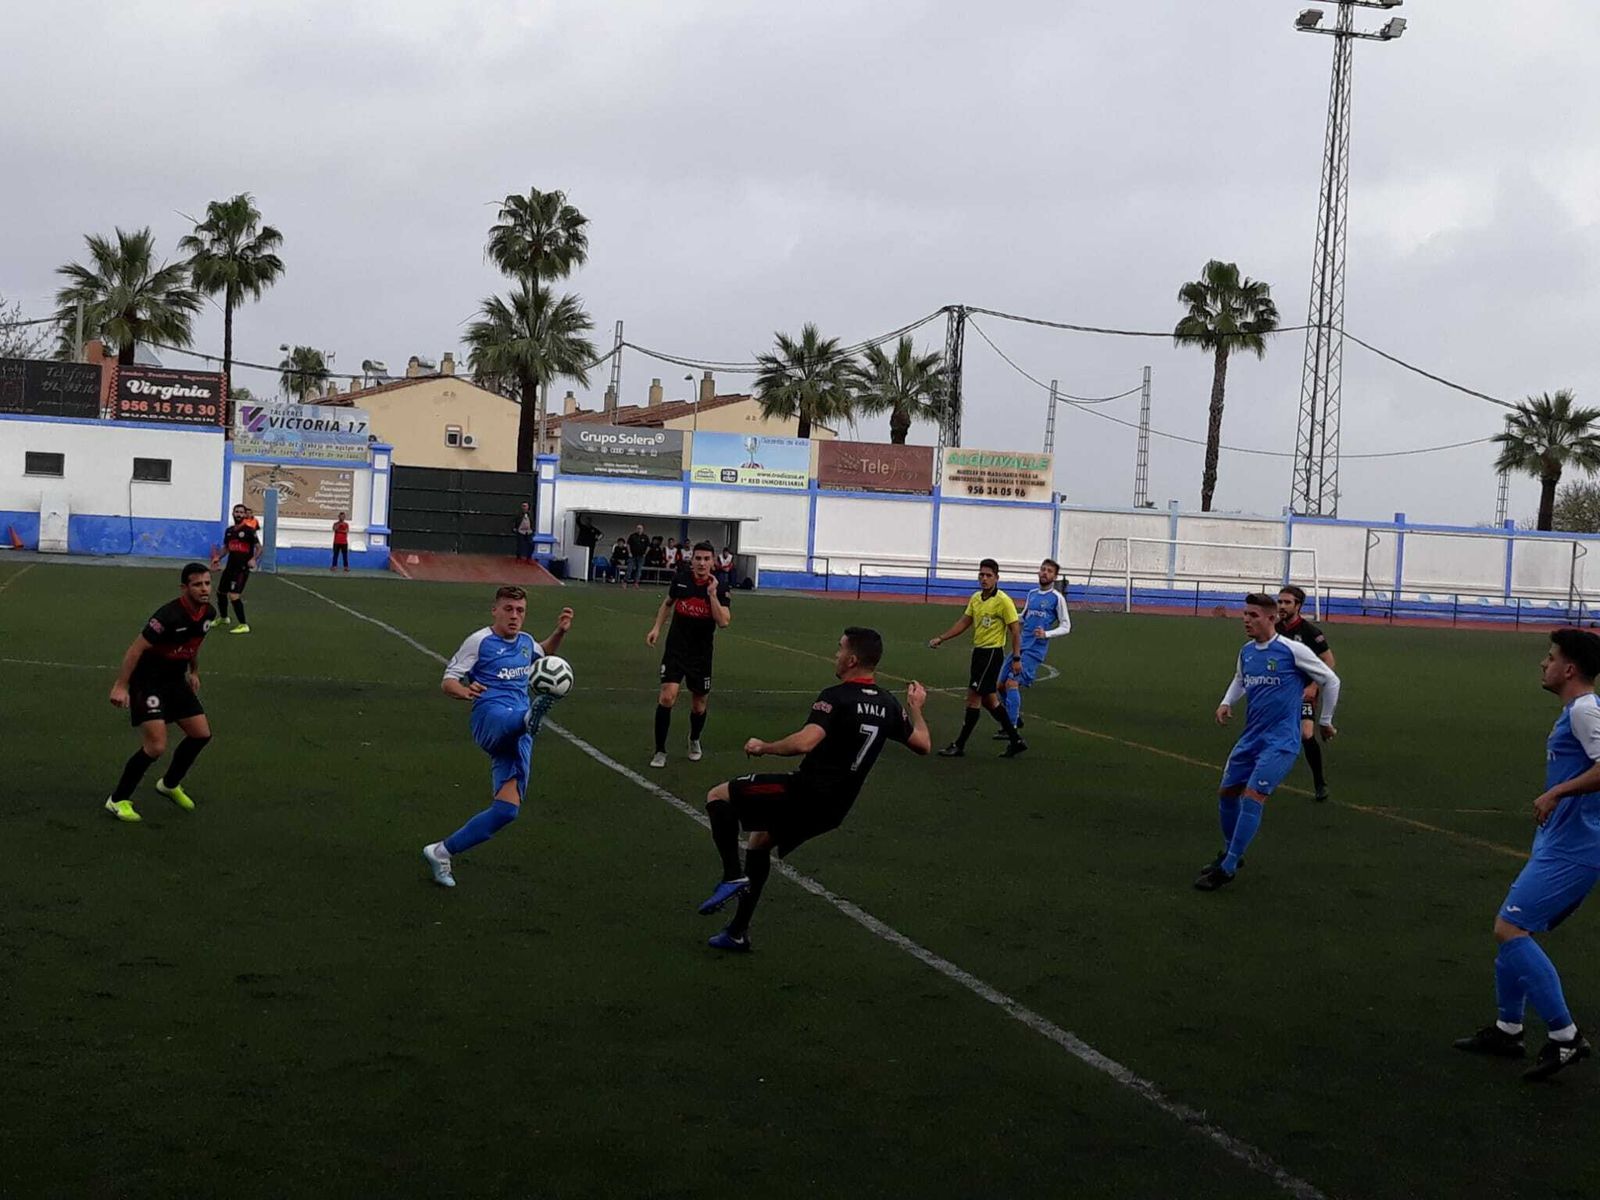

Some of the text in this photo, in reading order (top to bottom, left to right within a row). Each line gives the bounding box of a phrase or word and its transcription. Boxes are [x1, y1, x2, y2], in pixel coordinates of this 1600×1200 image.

[126, 379, 211, 400] Virginia
[120, 400, 216, 416] 956 15 76 30
[269, 409, 303, 417] TALLERES
[269, 417, 367, 434] VICTORIA 17
[580, 431, 656, 446] Grupo Solera
[860, 458, 890, 475] Tele
[761, 479, 805, 488] INMOBILIARIA
[967, 485, 1026, 498] 956 34 05 96
[857, 702, 886, 719] AYALA
[1302, 705, 1313, 716] 25
[850, 723, 879, 772] 7
